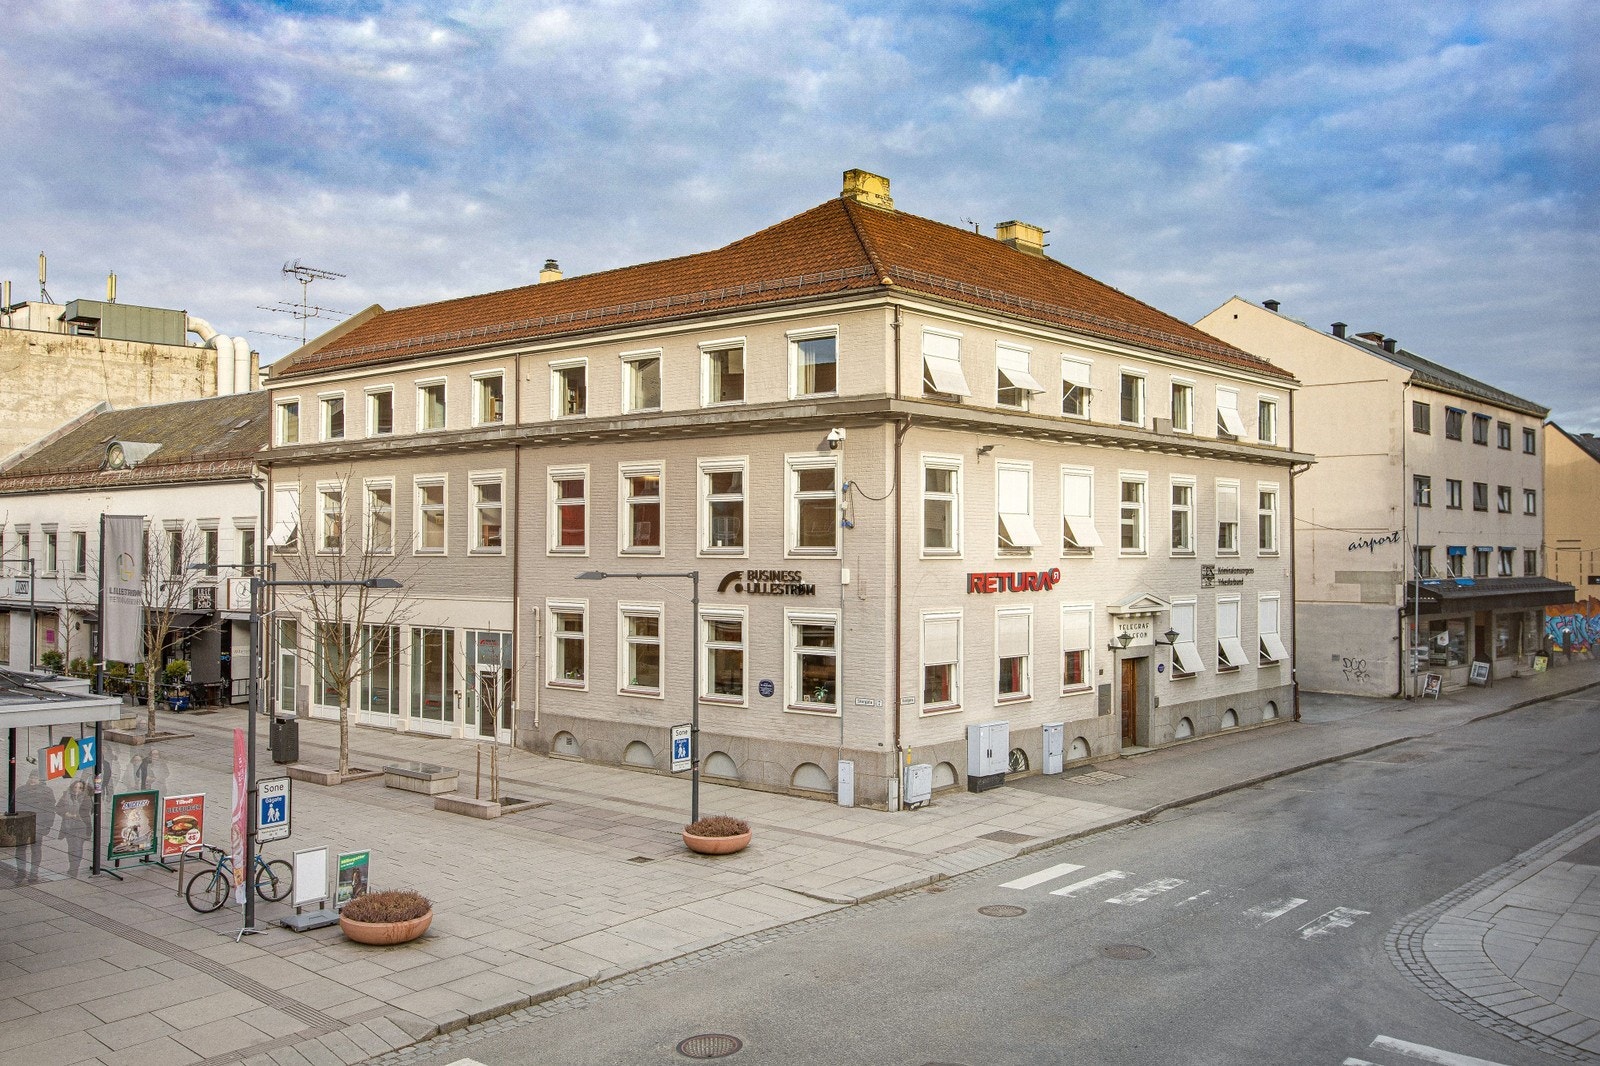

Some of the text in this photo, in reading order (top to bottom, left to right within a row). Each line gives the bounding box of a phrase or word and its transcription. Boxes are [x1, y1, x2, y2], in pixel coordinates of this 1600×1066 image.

[1348, 531, 1400, 554] airport
[746, 570, 802, 582] BUSINESS
[967, 571, 1053, 594] RETURA
[746, 582, 816, 596] LILLESTRØM
[1119, 622, 1150, 631] TELEGRAF
[50, 742, 94, 774] MIX
[263, 784, 284, 794] Sone
